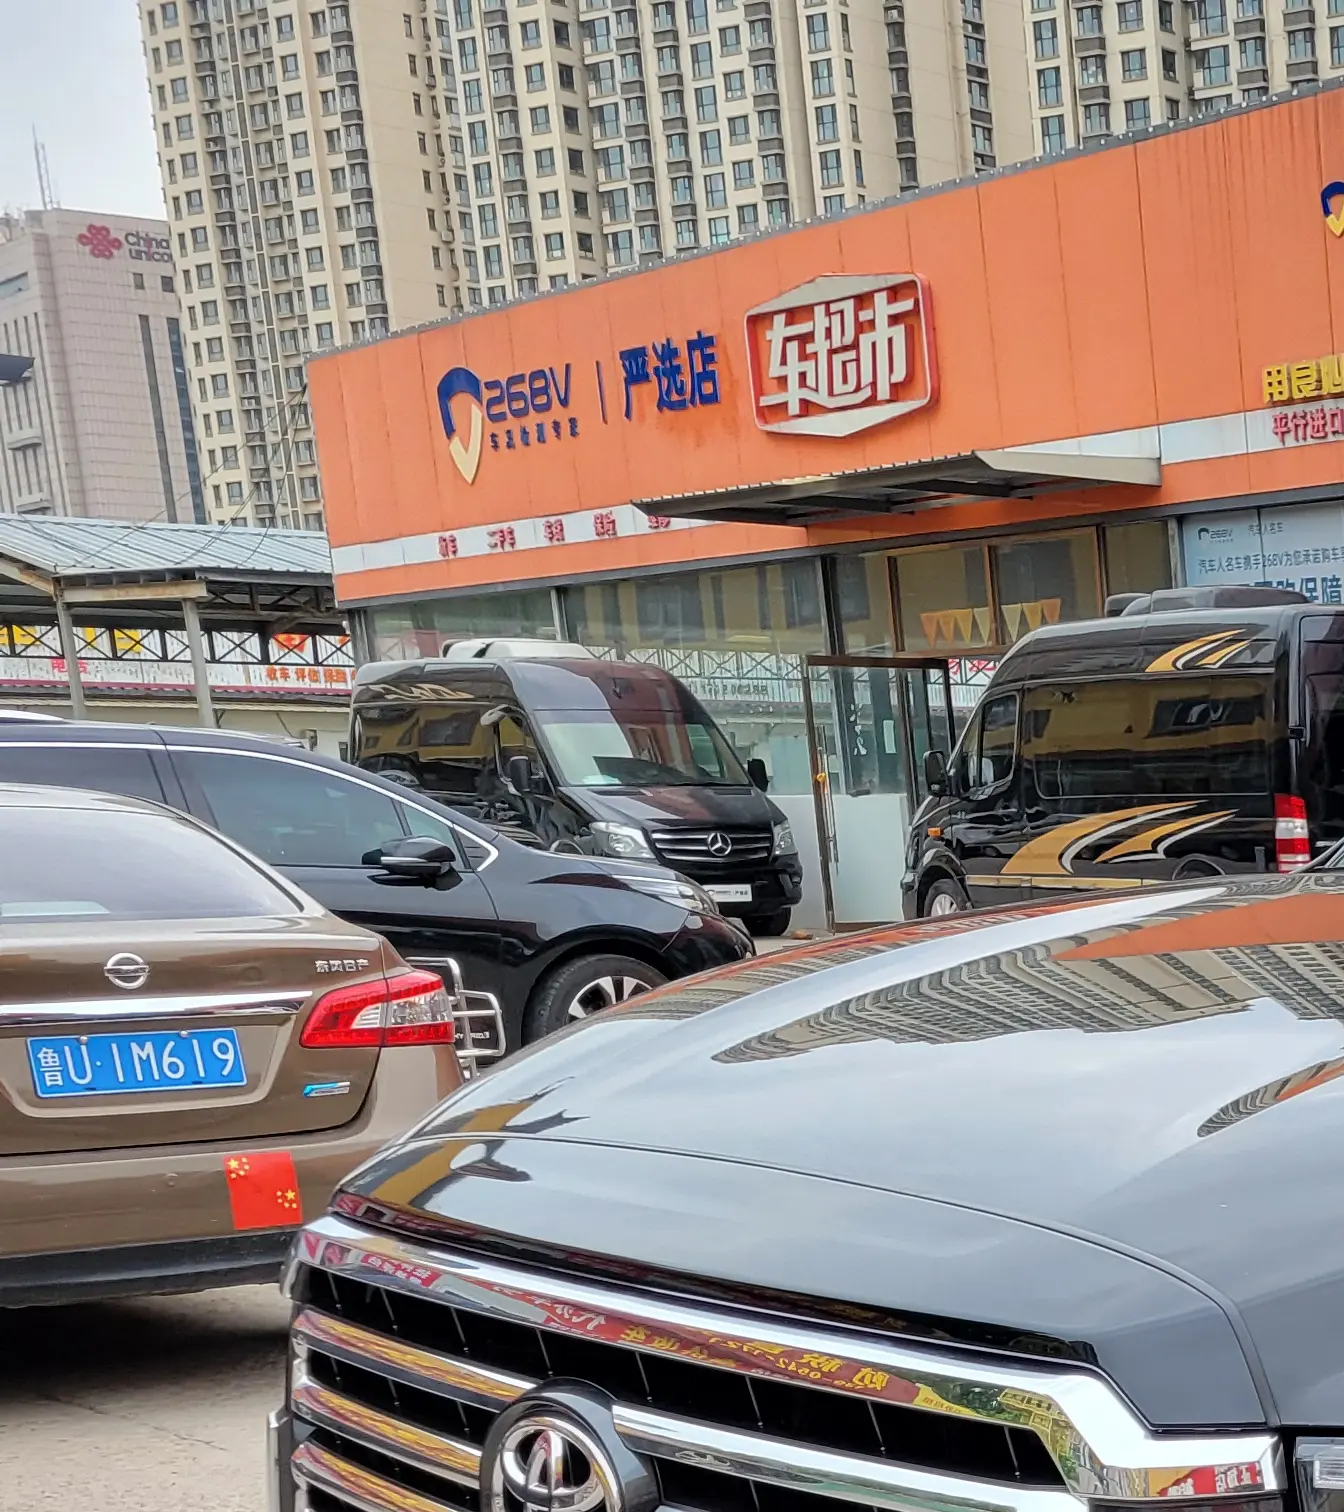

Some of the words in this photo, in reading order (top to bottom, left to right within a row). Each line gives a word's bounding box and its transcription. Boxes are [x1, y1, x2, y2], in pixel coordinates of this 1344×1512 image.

[128, 248, 173, 263] unico
[484, 363, 571, 423] 268V
[618, 330, 721, 421] 严选店
[1272, 404, 1344, 446] 平行进口
[315, 958, 370, 973] 东风日产
[36, 1036, 236, 1088] 鲁U·1M619
